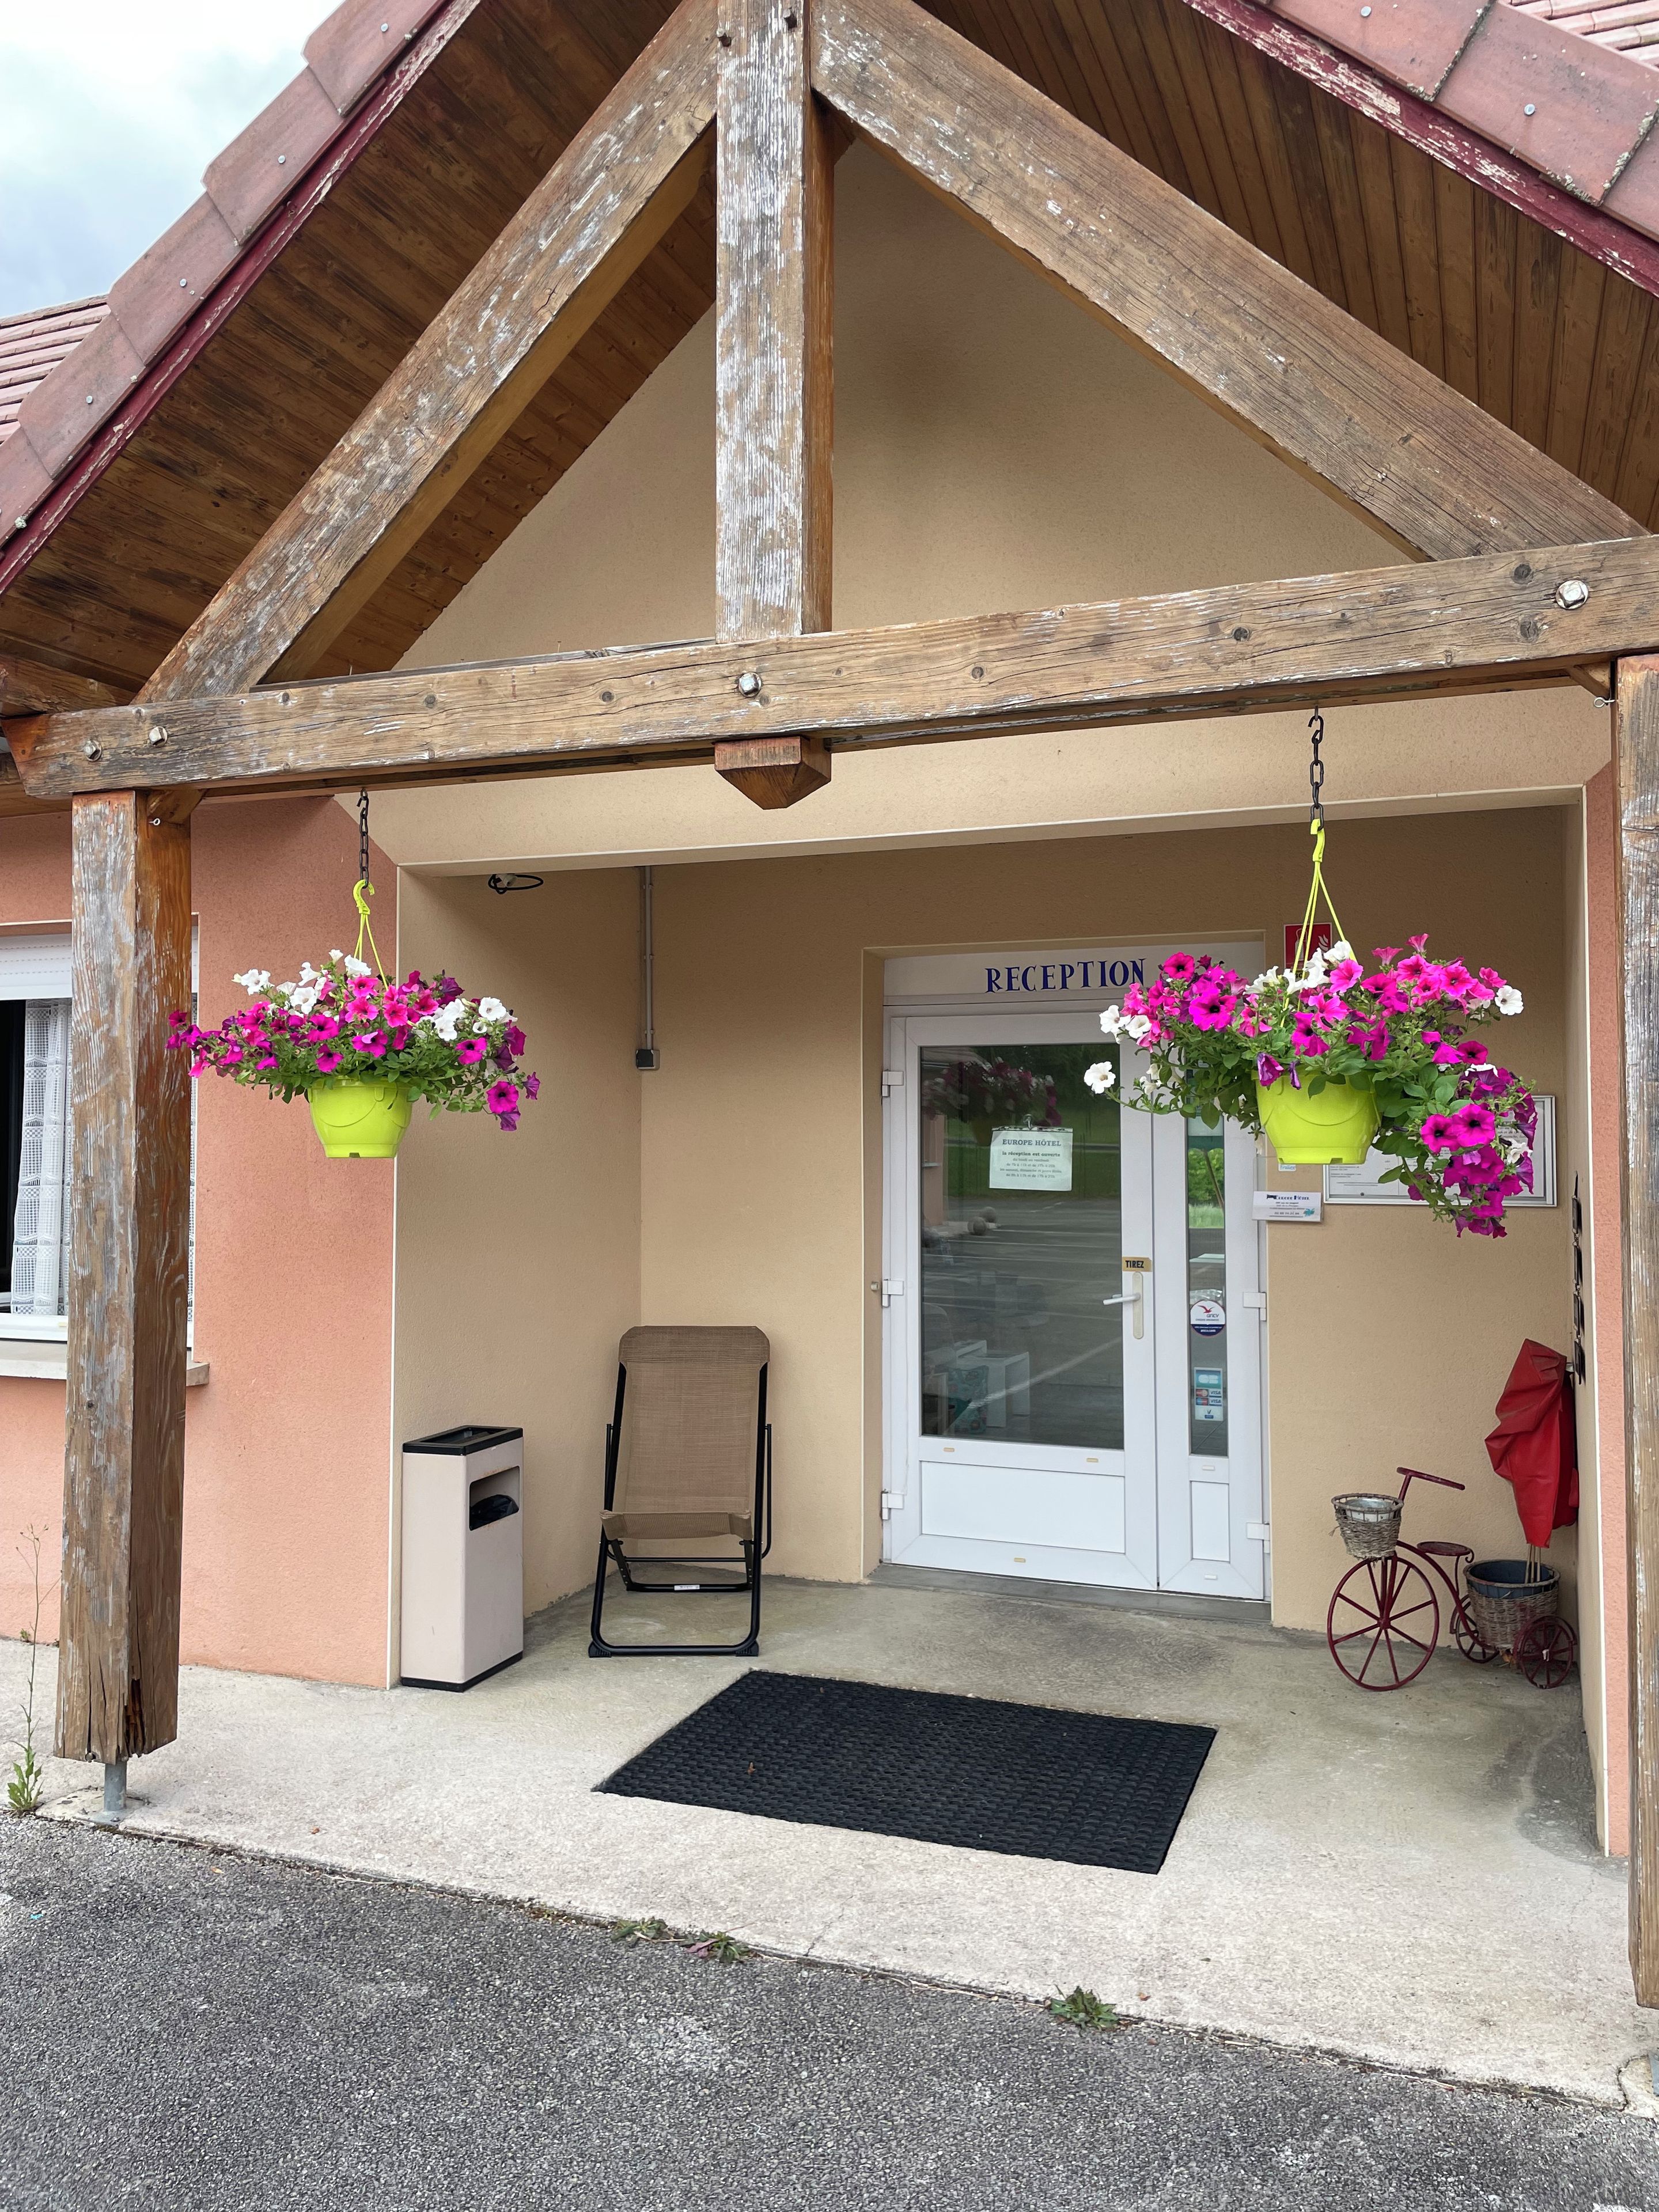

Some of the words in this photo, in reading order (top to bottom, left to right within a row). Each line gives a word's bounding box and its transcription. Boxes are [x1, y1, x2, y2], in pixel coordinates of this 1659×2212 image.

[984, 959, 1146, 993] RECEPTION
[1035, 1138, 1062, 1146] HÔTEL
[1125, 1260, 1144, 1268] TIREZ
